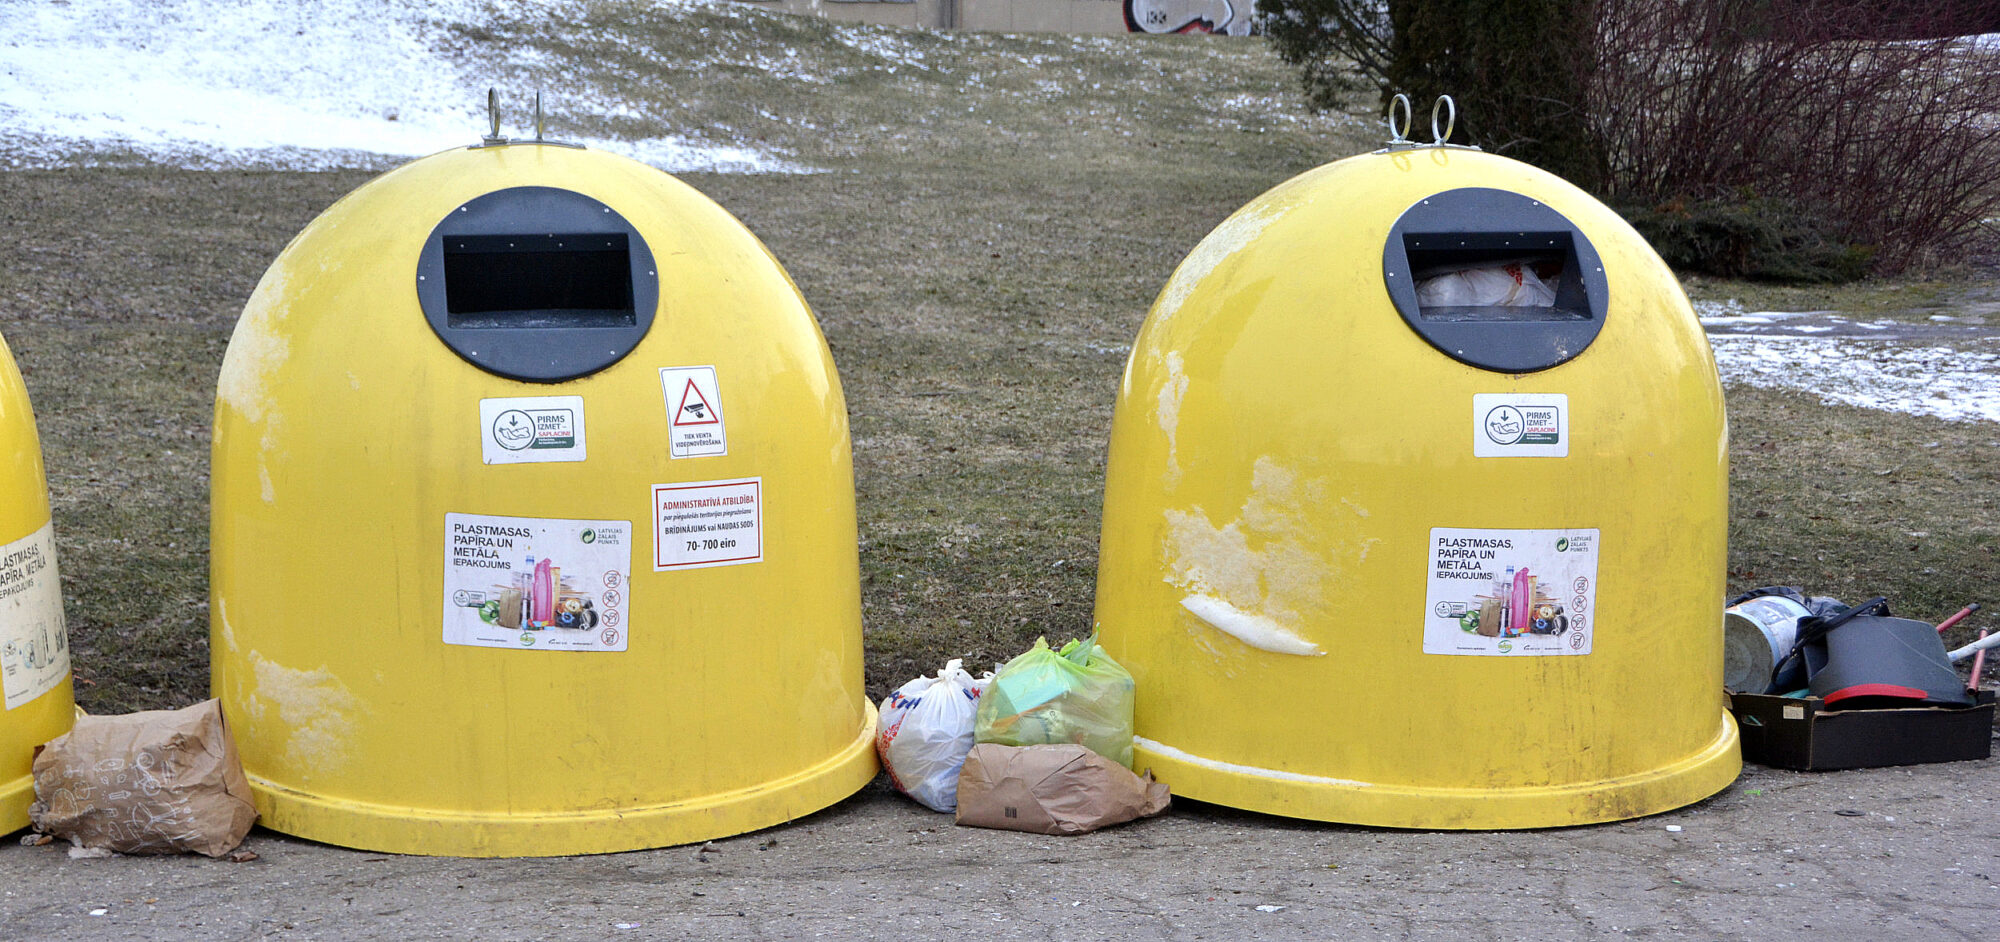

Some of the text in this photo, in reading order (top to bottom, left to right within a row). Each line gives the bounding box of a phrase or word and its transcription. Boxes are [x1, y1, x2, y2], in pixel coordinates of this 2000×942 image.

[537, 415, 565, 423] PIRMS
[1526, 411, 1551, 420] PIRMS
[675, 439, 722, 448] VIDEONOVĒROŠANA
[662, 494, 754, 510] ADMINISTRATĪVĀ ATBILDĪBA
[453, 523, 533, 541] PLASTMASAS,
[664, 525, 707, 535] BRĪDINĀJUMS
[717, 522, 740, 531] NAUDAS
[740, 520, 754, 529] SODS
[453, 535, 513, 548] PAPĪRA UN
[702, 539, 718, 550] 700
[720, 538, 736, 548] eiro
[1438, 537, 1514, 550] PLASTMASAS,
[0, 543, 40, 571] LASTMASAS
[453, 546, 499, 559] METĀLA
[1438, 548, 1495, 560] PAPĪRA UN
[453, 558, 511, 570] IEPAKOJUMS
[1437, 559, 1481, 570] METĀLA
[0, 567, 25, 587] APĪRA,
[1436, 571, 1493, 580] IEPAKOJUMS
[0, 577, 34, 600] EPAKOJUMS
